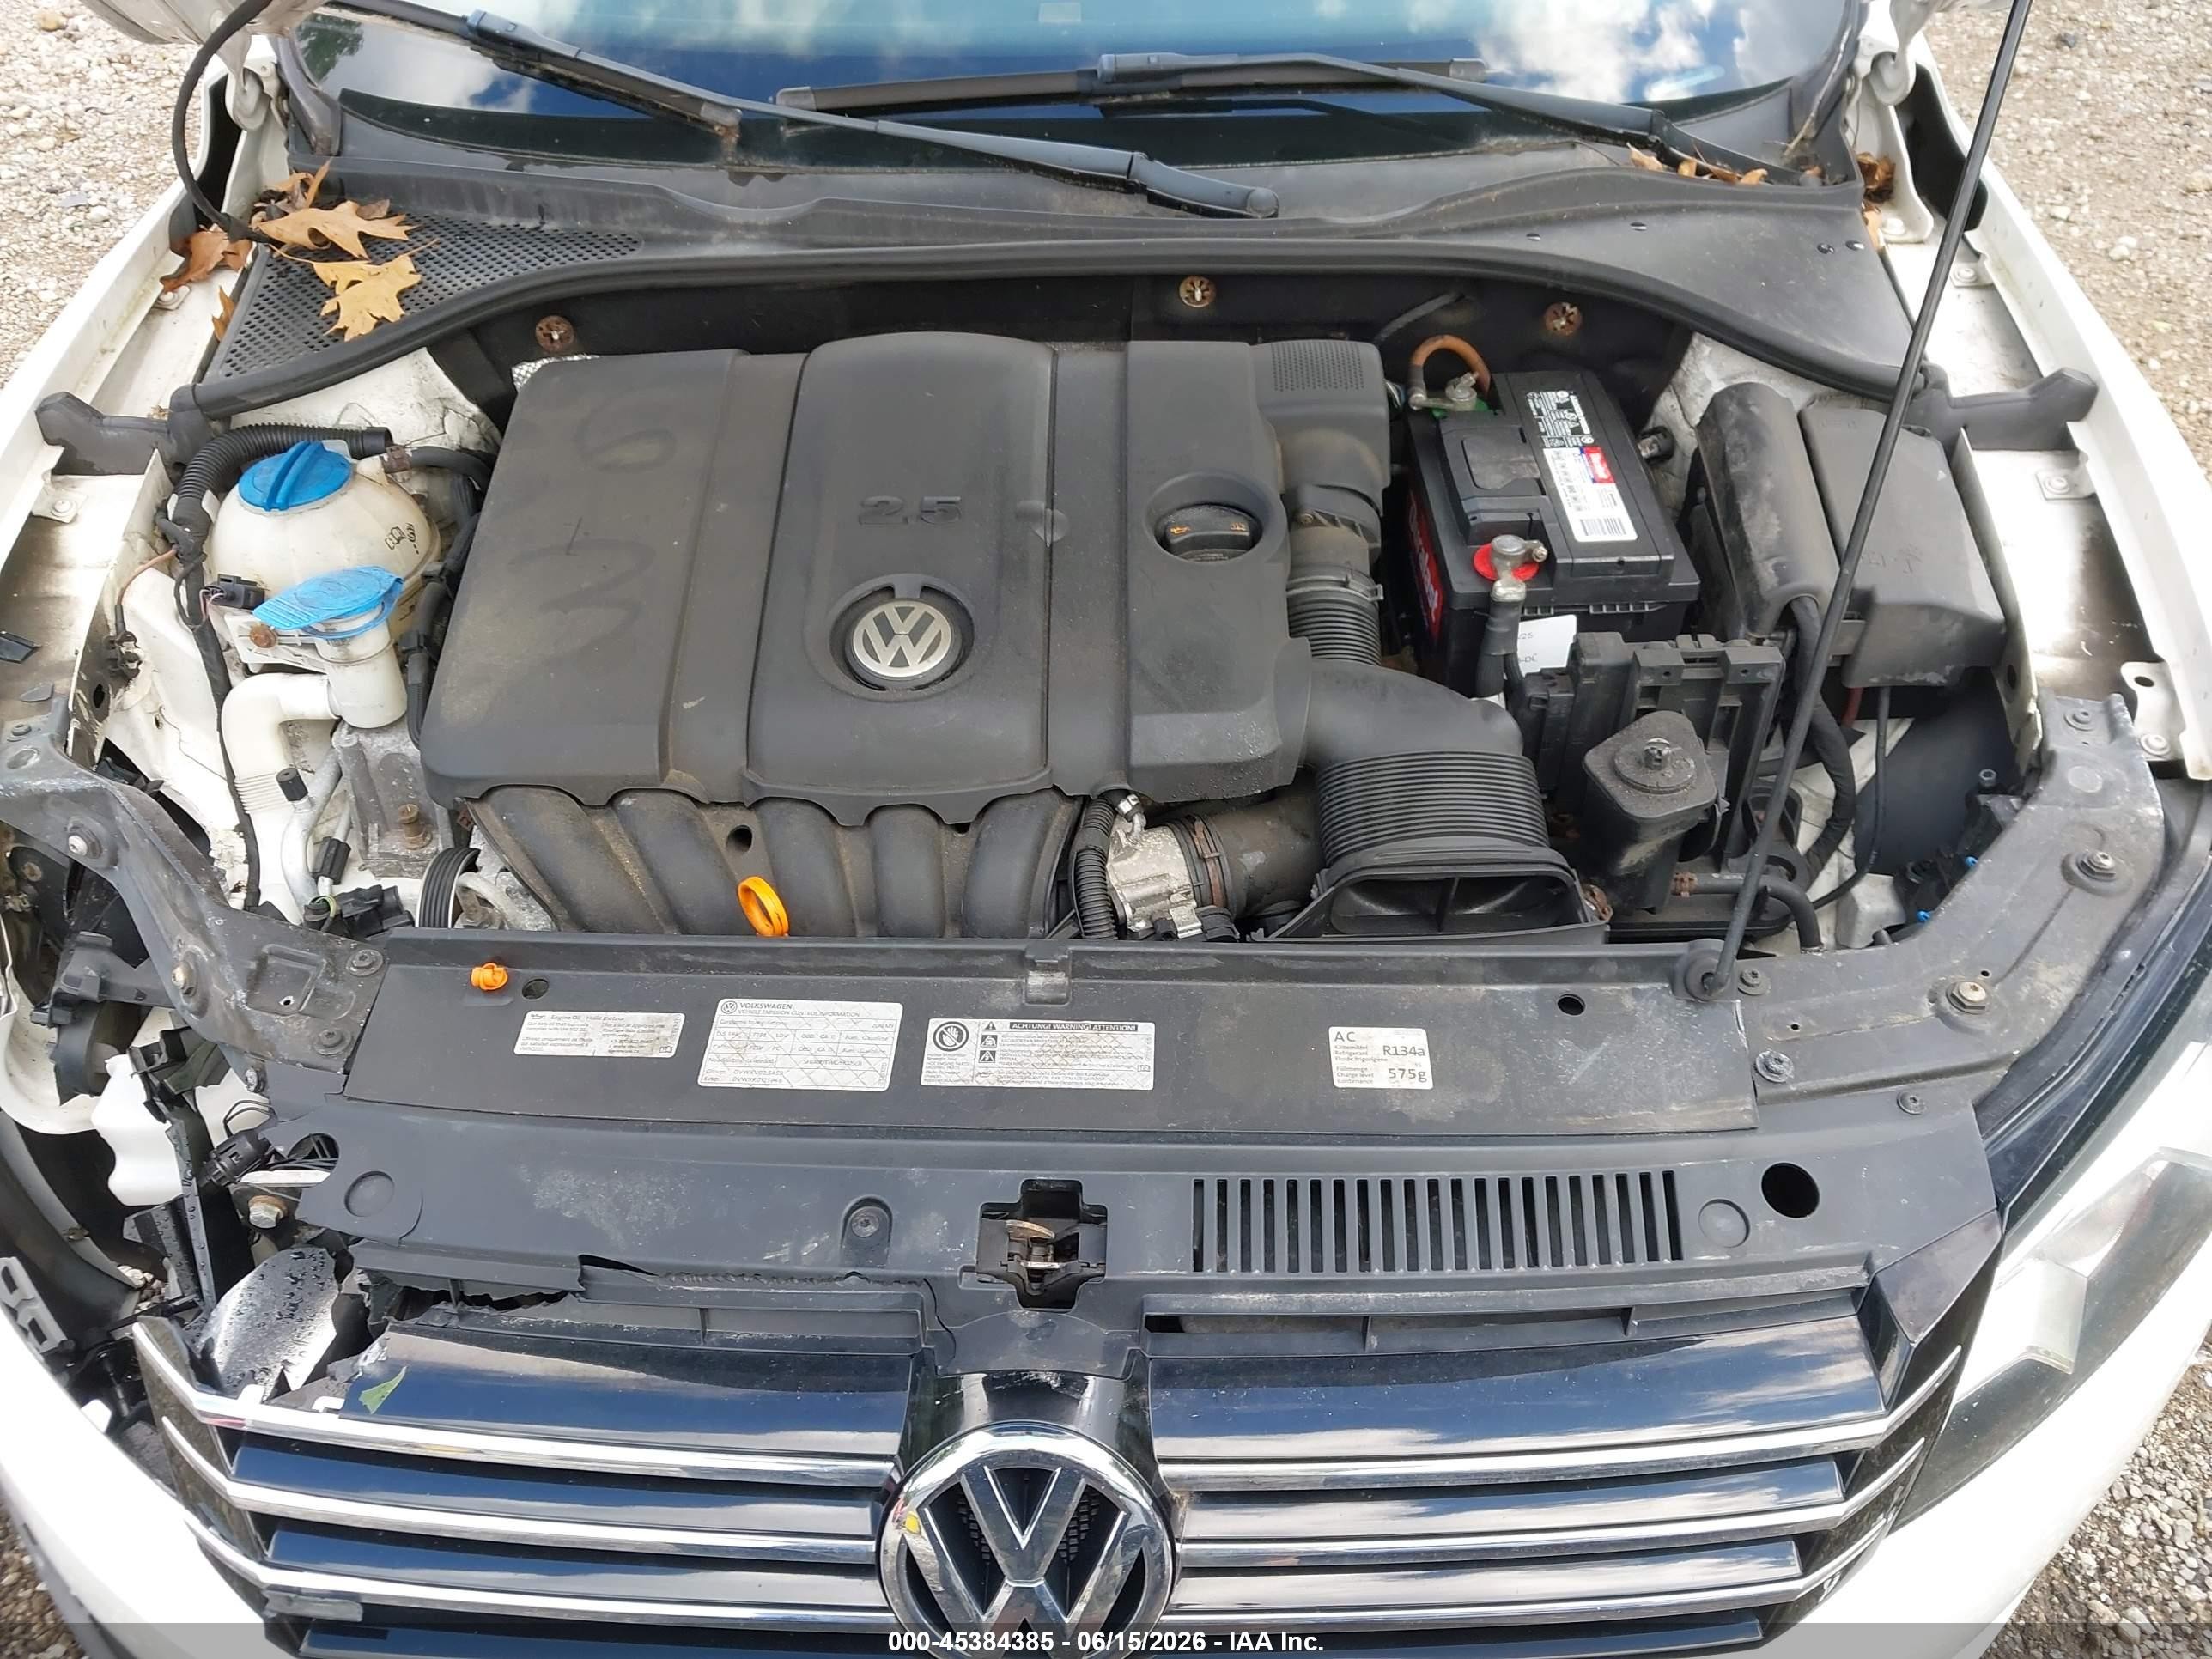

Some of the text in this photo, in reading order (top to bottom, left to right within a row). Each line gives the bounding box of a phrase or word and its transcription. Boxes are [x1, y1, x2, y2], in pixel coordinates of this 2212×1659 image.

[857, 495, 963, 526] 2.5
[739, 1002, 793, 1011] VOLKSWAGEN
[1012, 1022, 1137, 1032] ACHTUNG! WARNING! ATTENTION!
[1382, 1045, 1425, 1057] R134a
[1388, 1067, 1428, 1083] 575g
